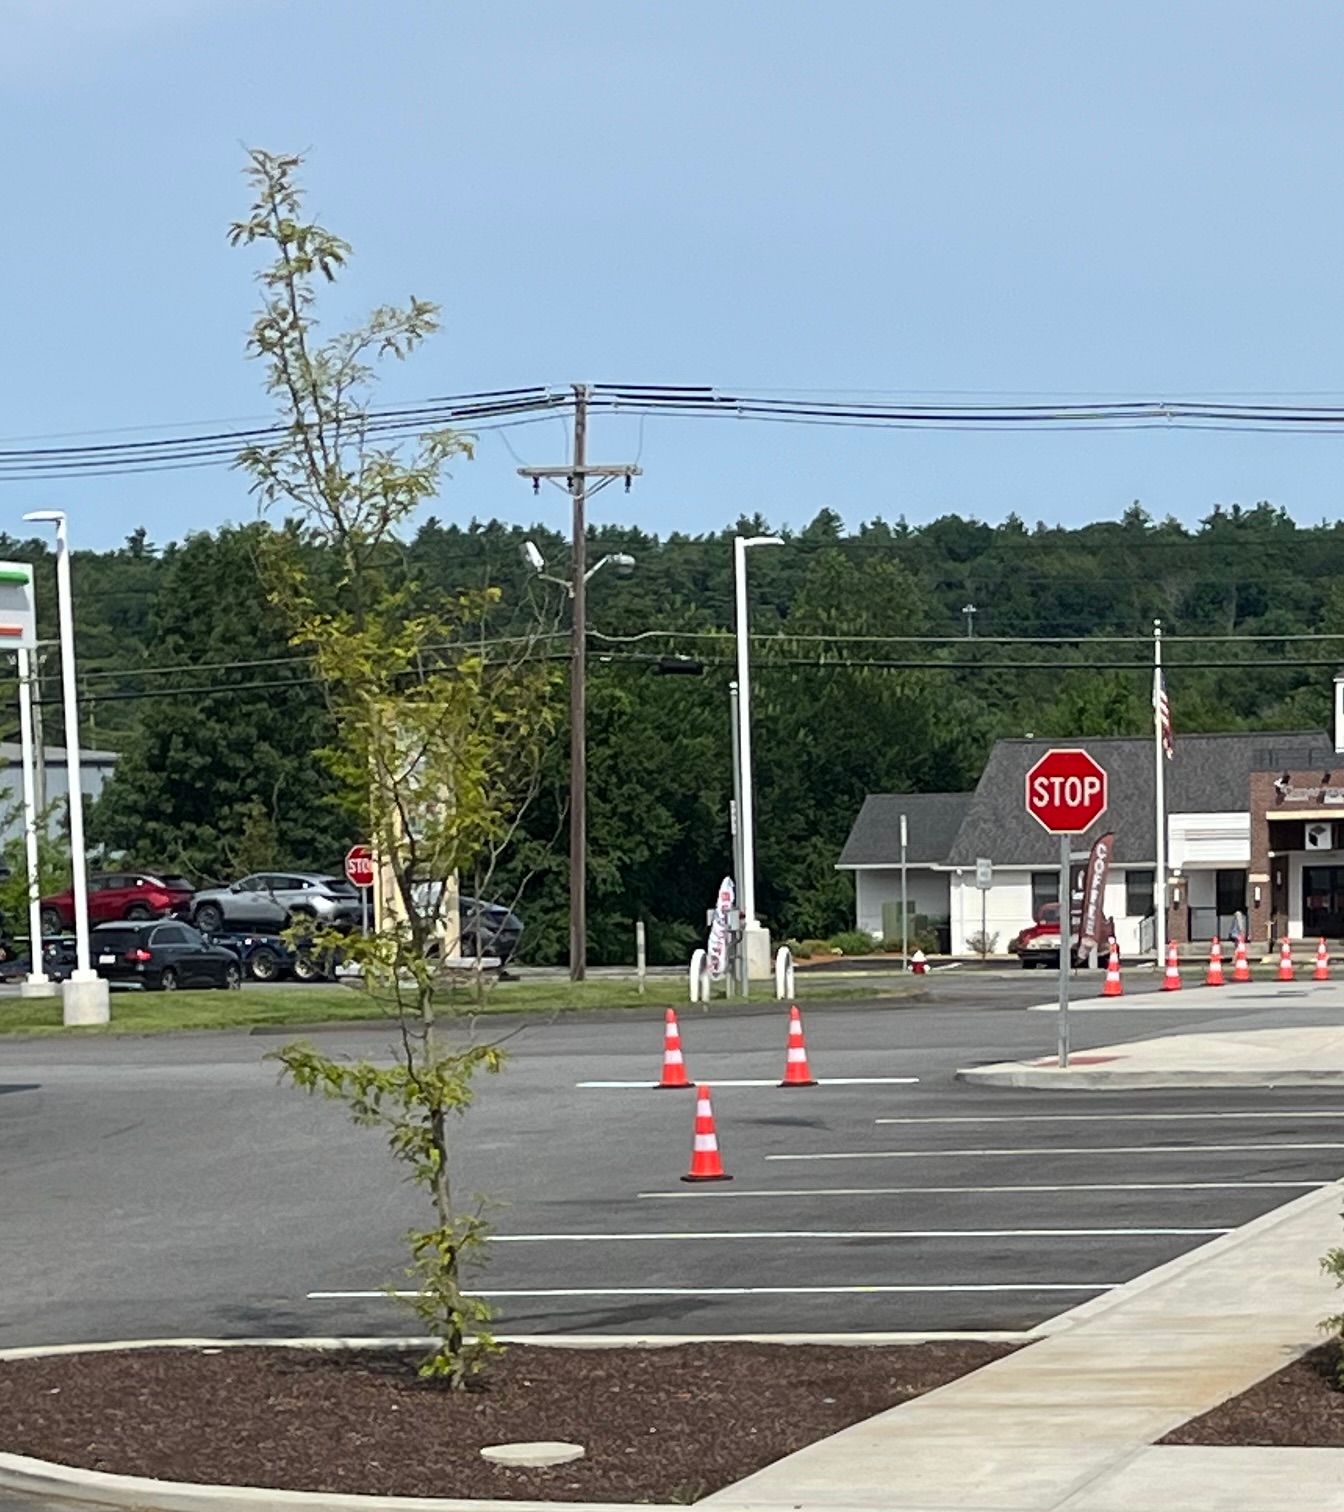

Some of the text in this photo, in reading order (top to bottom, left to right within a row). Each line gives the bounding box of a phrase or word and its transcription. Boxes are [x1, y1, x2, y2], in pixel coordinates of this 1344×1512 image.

[1032, 776, 1101, 808] STOP
[347, 858, 373, 874] STO
[1086, 843, 1108, 936] COFFEE
